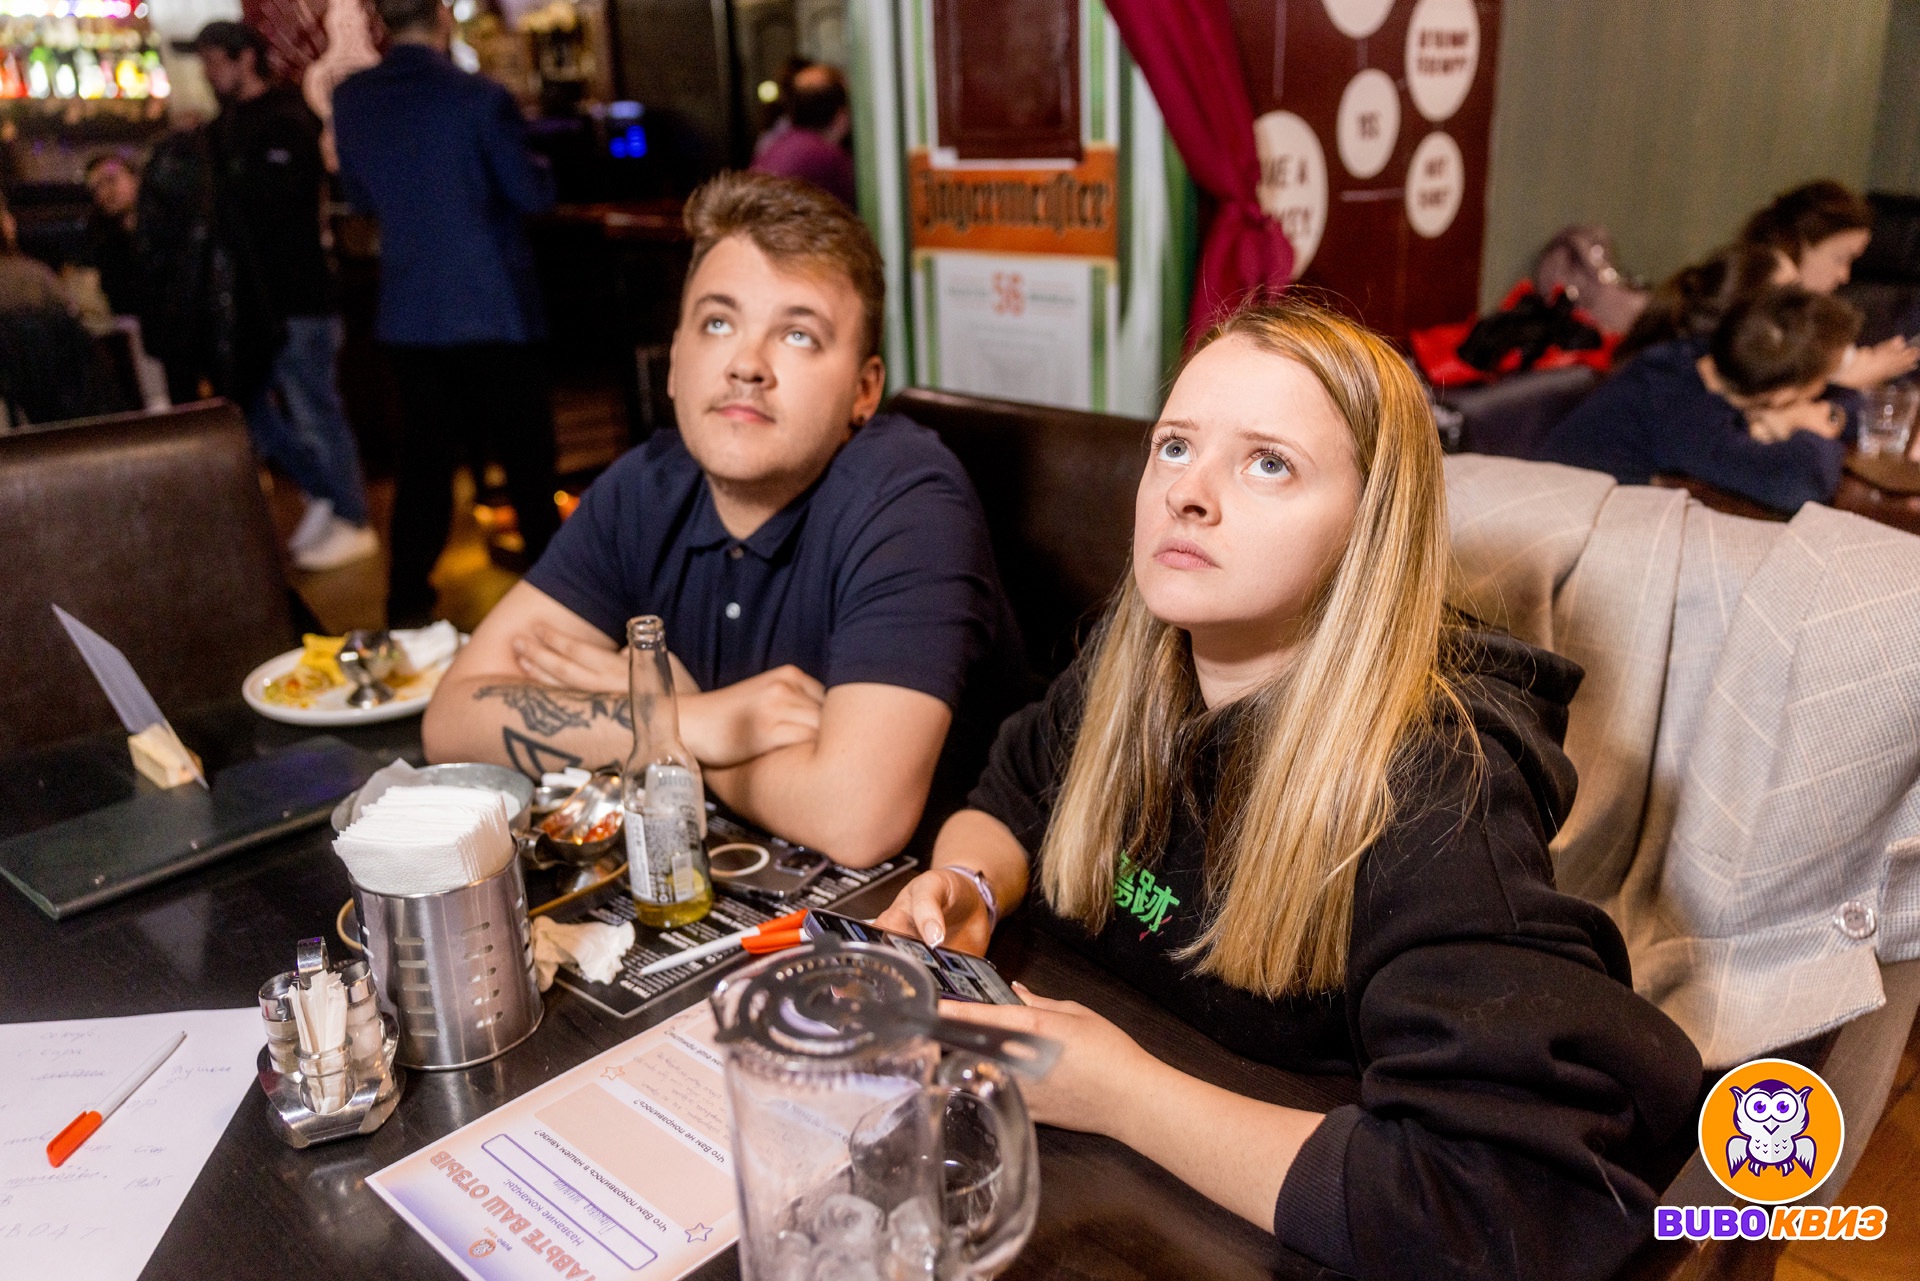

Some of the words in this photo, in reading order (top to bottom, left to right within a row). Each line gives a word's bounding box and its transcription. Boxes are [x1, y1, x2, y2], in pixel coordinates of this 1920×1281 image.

[633, 1098, 685, 1134] понравилось?
[534, 1129, 560, 1150] квизе?
[684, 1132, 695, 1141] не
[695, 1139, 712, 1153] Вам
[559, 1146, 584, 1167] нашем
[711, 1150, 725, 1163] Что
[430, 1150, 490, 1199] ОТЗЫВ
[583, 1164, 591, 1172] в
[503, 1179, 543, 1212] команды:
[589, 1168, 638, 1207] понравилось
[481, 1195, 532, 1235] ВАШ
[636, 1204, 654, 1221] Вам
[541, 1209, 584, 1247] Название
[652, 1217, 667, 1233] Что
